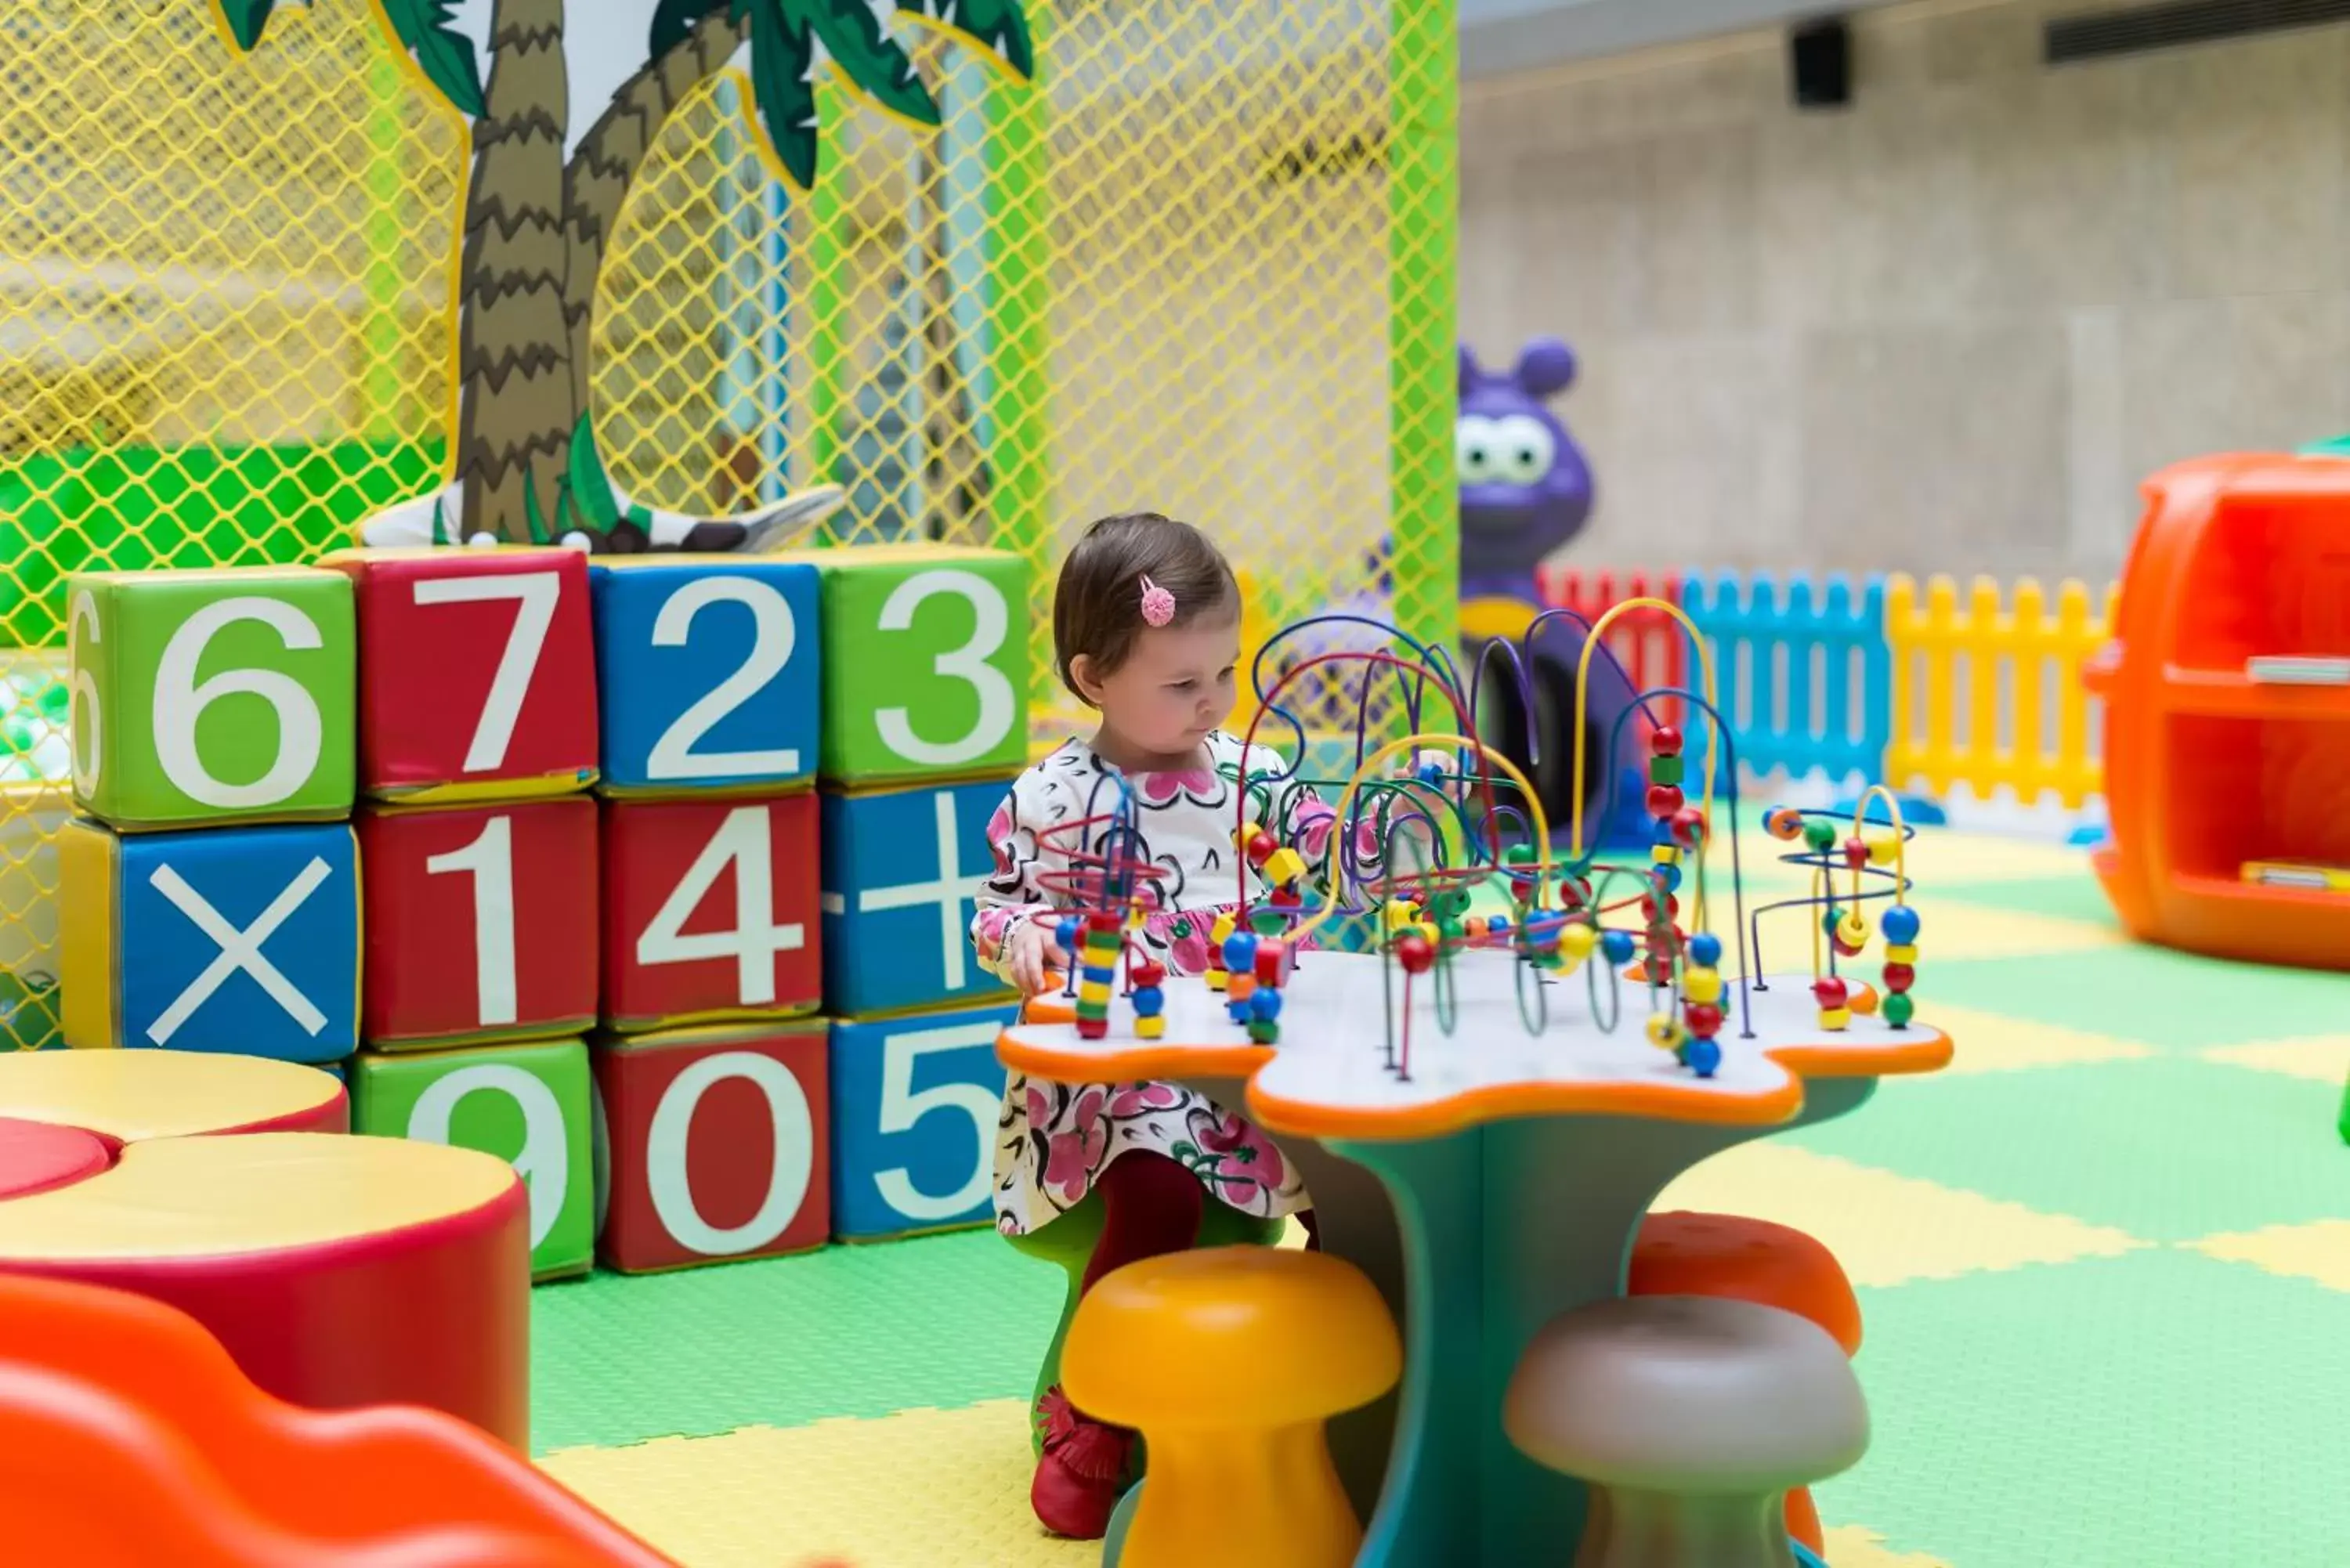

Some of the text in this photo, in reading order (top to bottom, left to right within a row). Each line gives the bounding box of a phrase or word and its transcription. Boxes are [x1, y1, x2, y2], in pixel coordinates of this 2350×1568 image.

[70, 589, 101, 800] 6
[153, 596, 324, 808] 6
[414, 571, 560, 773] 7
[647, 576, 800, 779] 2
[875, 569, 1016, 765] 3
[427, 815, 517, 1026] 1
[637, 805, 804, 1006] 4
[647, 1051, 813, 1255] 0
[873, 1021, 1002, 1220] 5
